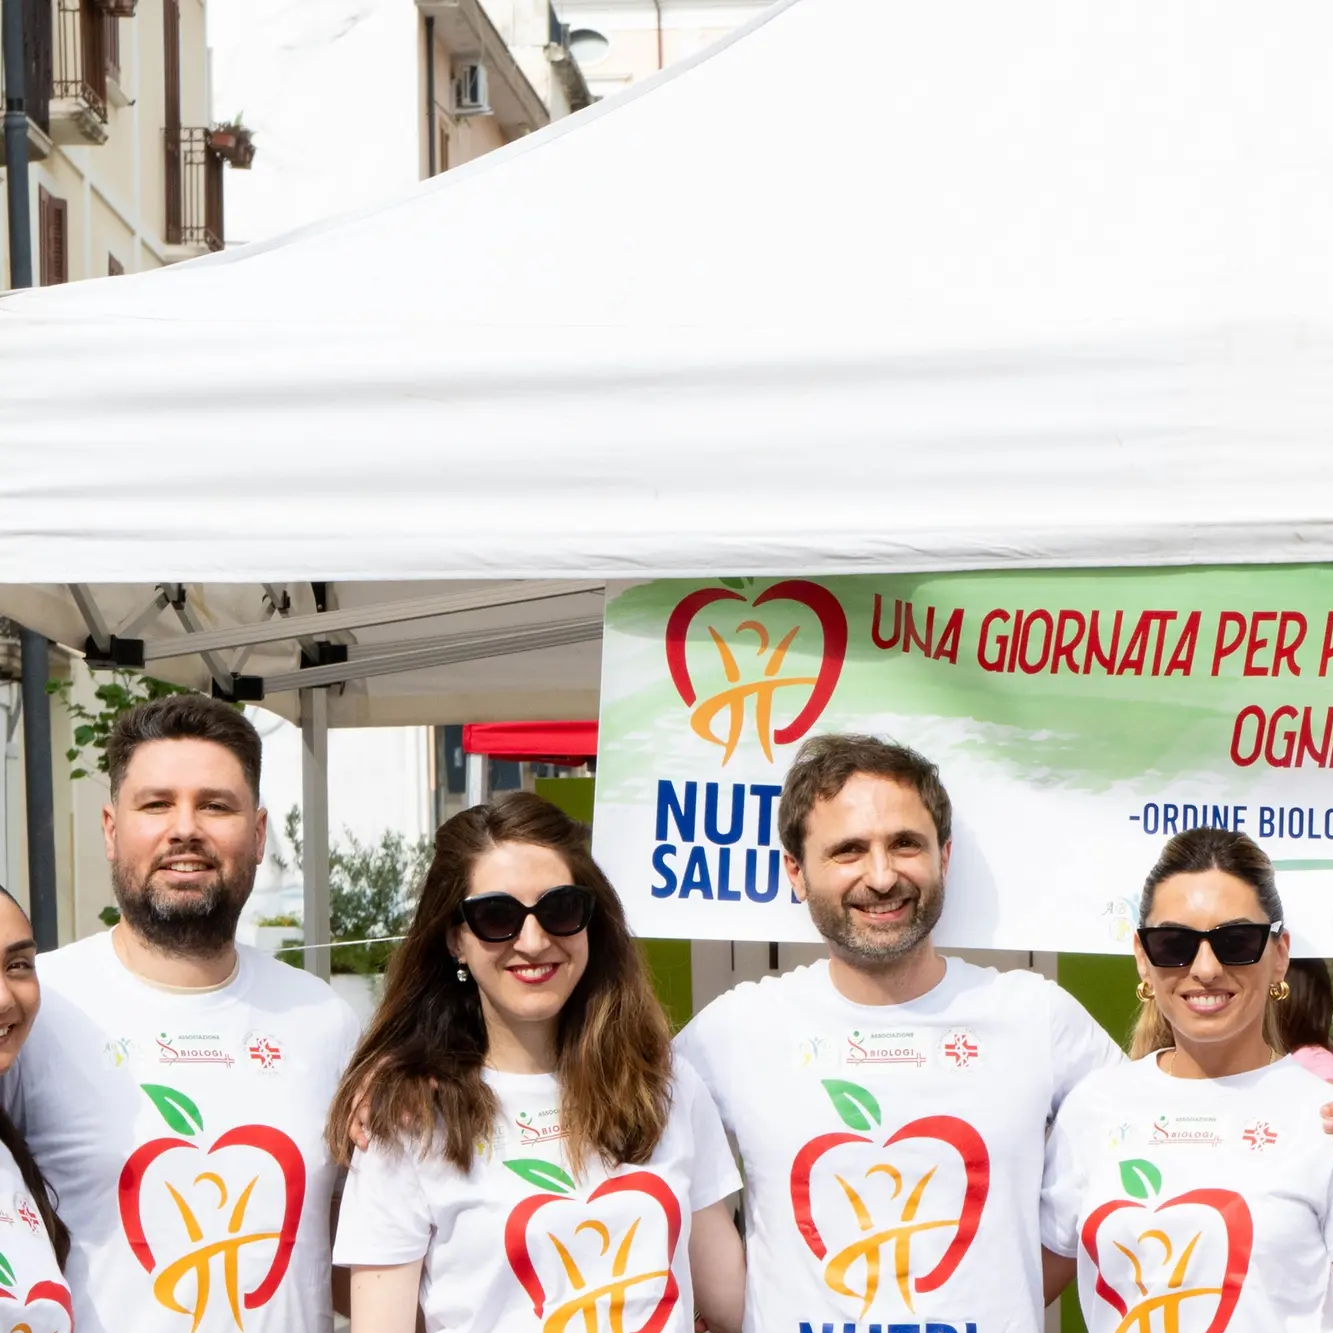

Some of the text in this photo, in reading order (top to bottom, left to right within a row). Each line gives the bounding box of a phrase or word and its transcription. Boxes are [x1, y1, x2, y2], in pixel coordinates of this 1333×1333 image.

[871, 593, 965, 665] UNA
[977, 608, 1202, 676] GIORNATA
[1211, 611, 1307, 677] PER
[655, 779, 783, 846] NUT
[651, 843, 801, 904] SALU
[869, 1049, 914, 1057] BIOLOGI
